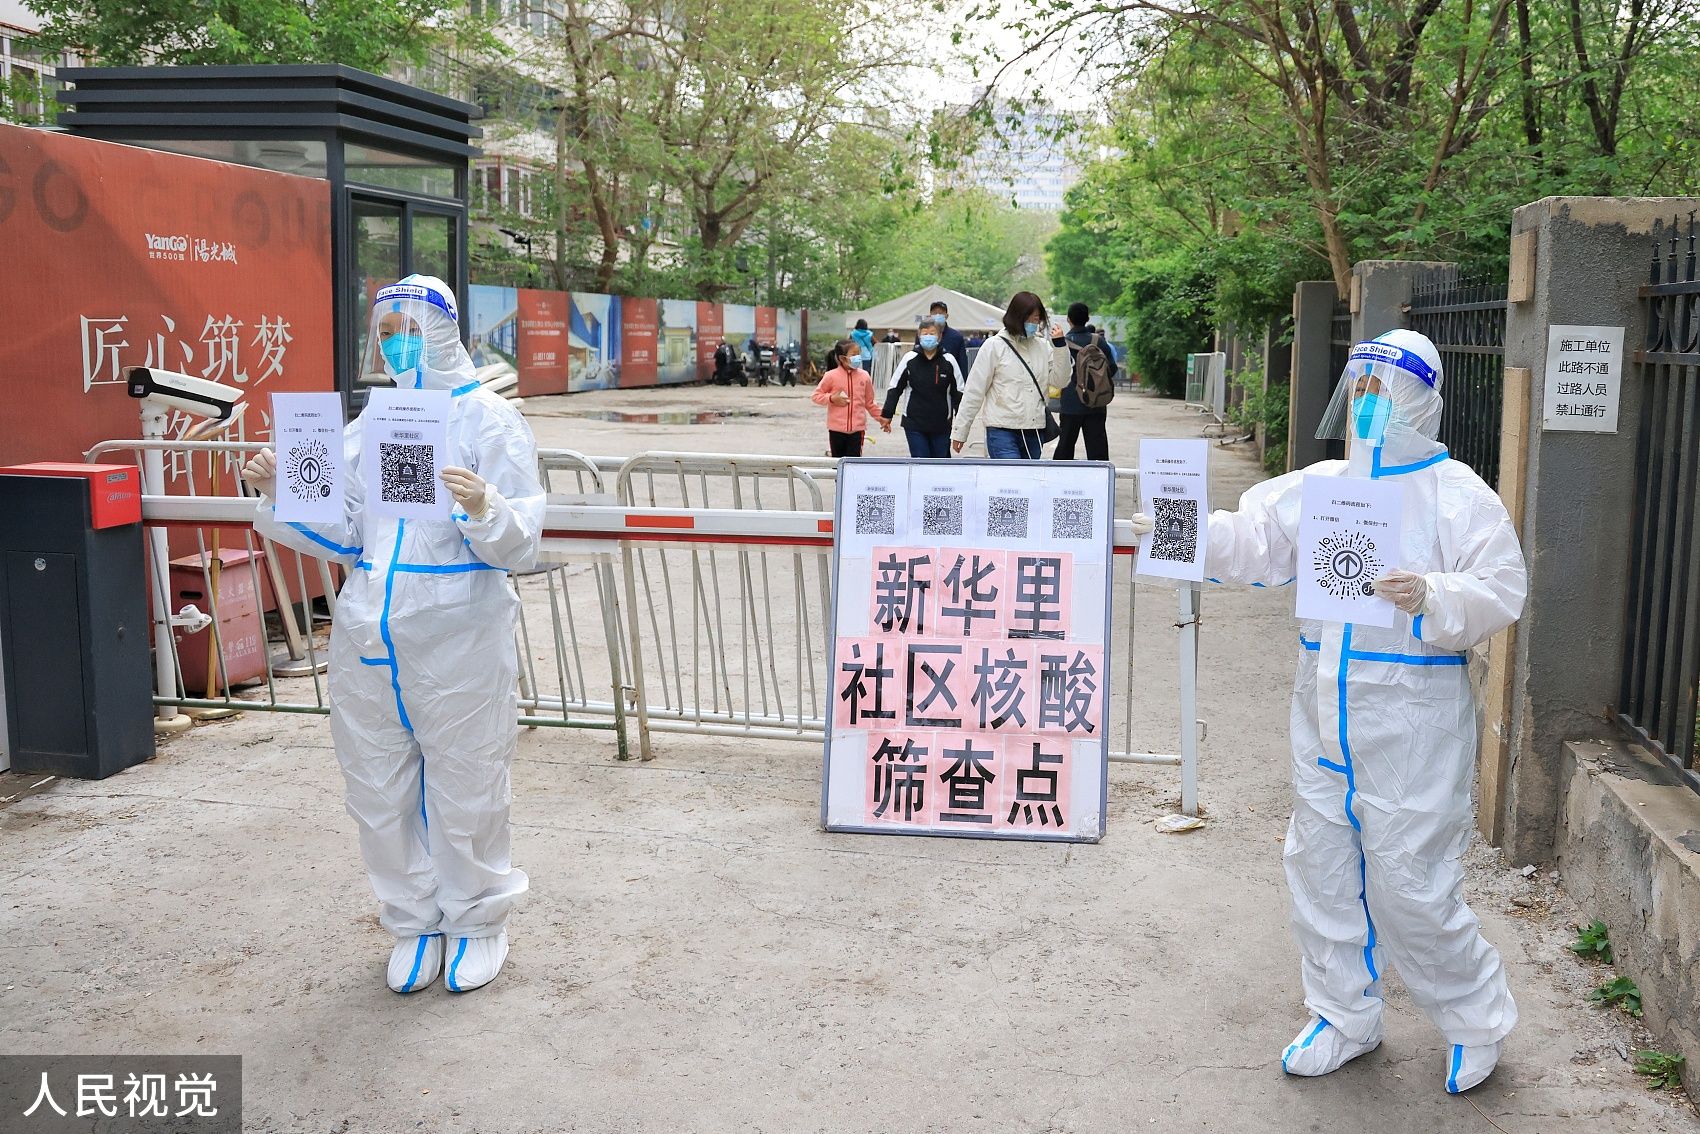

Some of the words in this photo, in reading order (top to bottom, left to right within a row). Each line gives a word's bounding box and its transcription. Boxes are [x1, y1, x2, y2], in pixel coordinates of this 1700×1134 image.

[395, 286, 423, 295] Shield
[1369, 345, 1398, 358] Shield
[1560, 339, 1611, 353] 施工单位
[80, 313, 294, 394] 匠心筑梦
[1558, 360, 1609, 375] 此路不通
[1557, 382, 1608, 396] 过路人员
[1555, 403, 1607, 417] 禁止通行
[873, 552, 1066, 641] 新华里
[840, 641, 1098, 734] 社区核酸
[871, 736, 1065, 828] 筛查点
